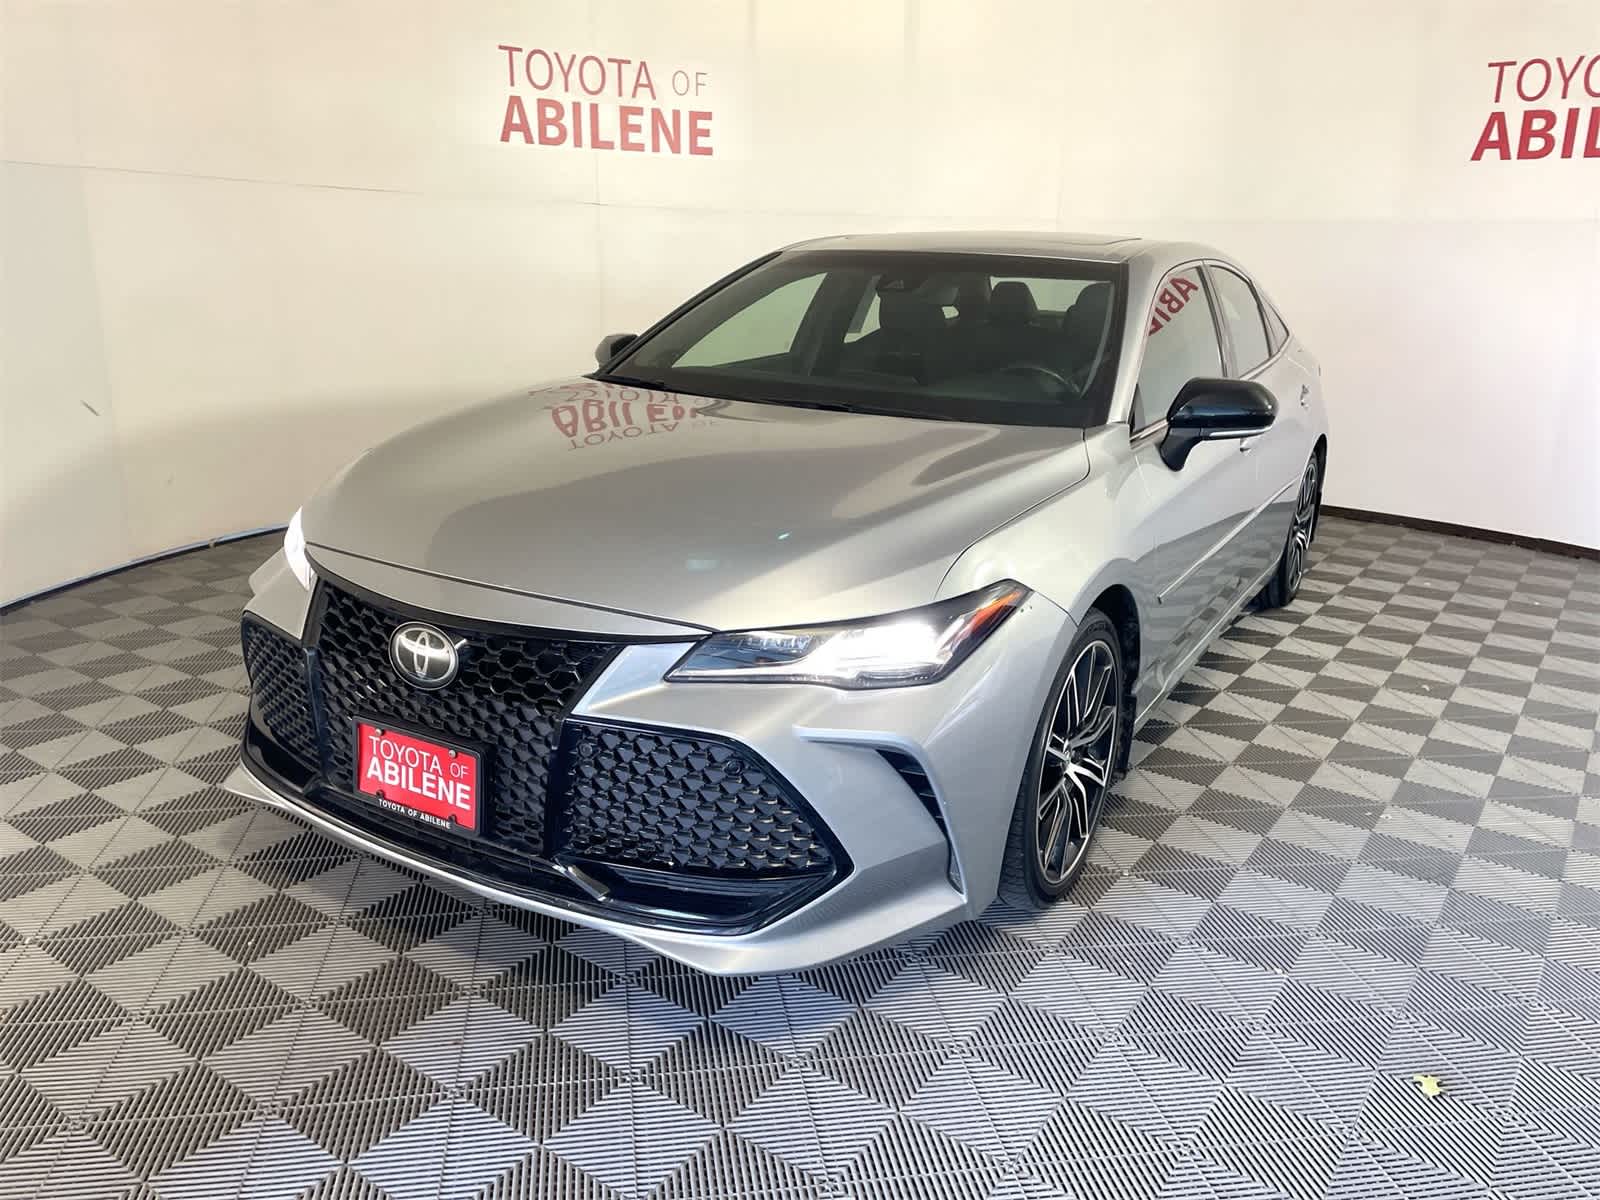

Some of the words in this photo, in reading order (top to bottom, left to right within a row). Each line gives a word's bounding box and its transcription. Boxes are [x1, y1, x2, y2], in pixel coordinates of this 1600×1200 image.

[498, 45, 656, 100] TOYOTA
[672, 70, 708, 96] OF
[500, 95, 714, 156] ABILENE
[366, 756, 471, 811] ABILENE
[368, 735, 443, 776] TOYOTA
[450, 762, 469, 779] OF
[378, 798, 406, 815] TOYOTA
[407, 808, 418, 819] OF
[420, 813, 451, 830] ABILENE
